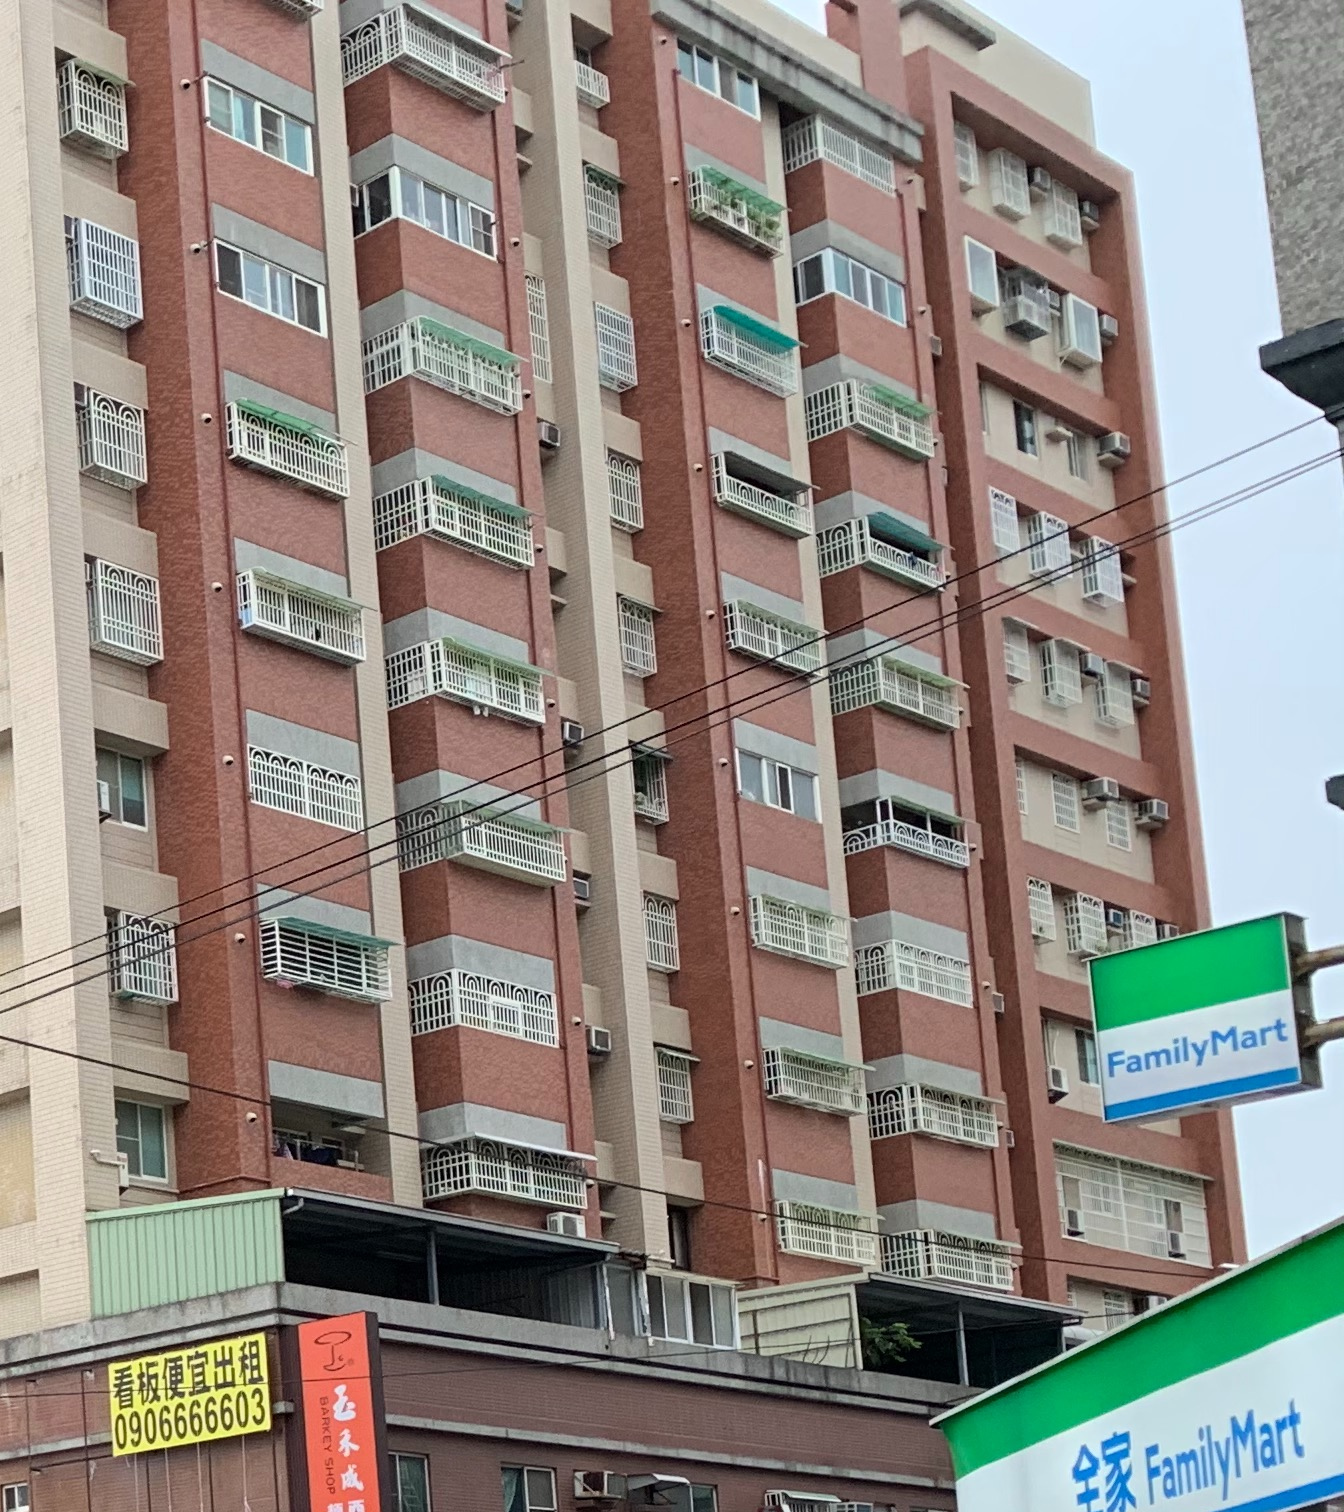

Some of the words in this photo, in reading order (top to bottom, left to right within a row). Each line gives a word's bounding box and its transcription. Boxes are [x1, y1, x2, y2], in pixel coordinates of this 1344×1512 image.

[1107, 1016, 1289, 1078] FamilyMart
[112, 1340, 265, 1411] 看板便宜出租
[114, 1386, 267, 1451] 0906666603
[324, 1457, 336, 1495] SHOP
[1145, 1399, 1305, 1505] FamilyMart
